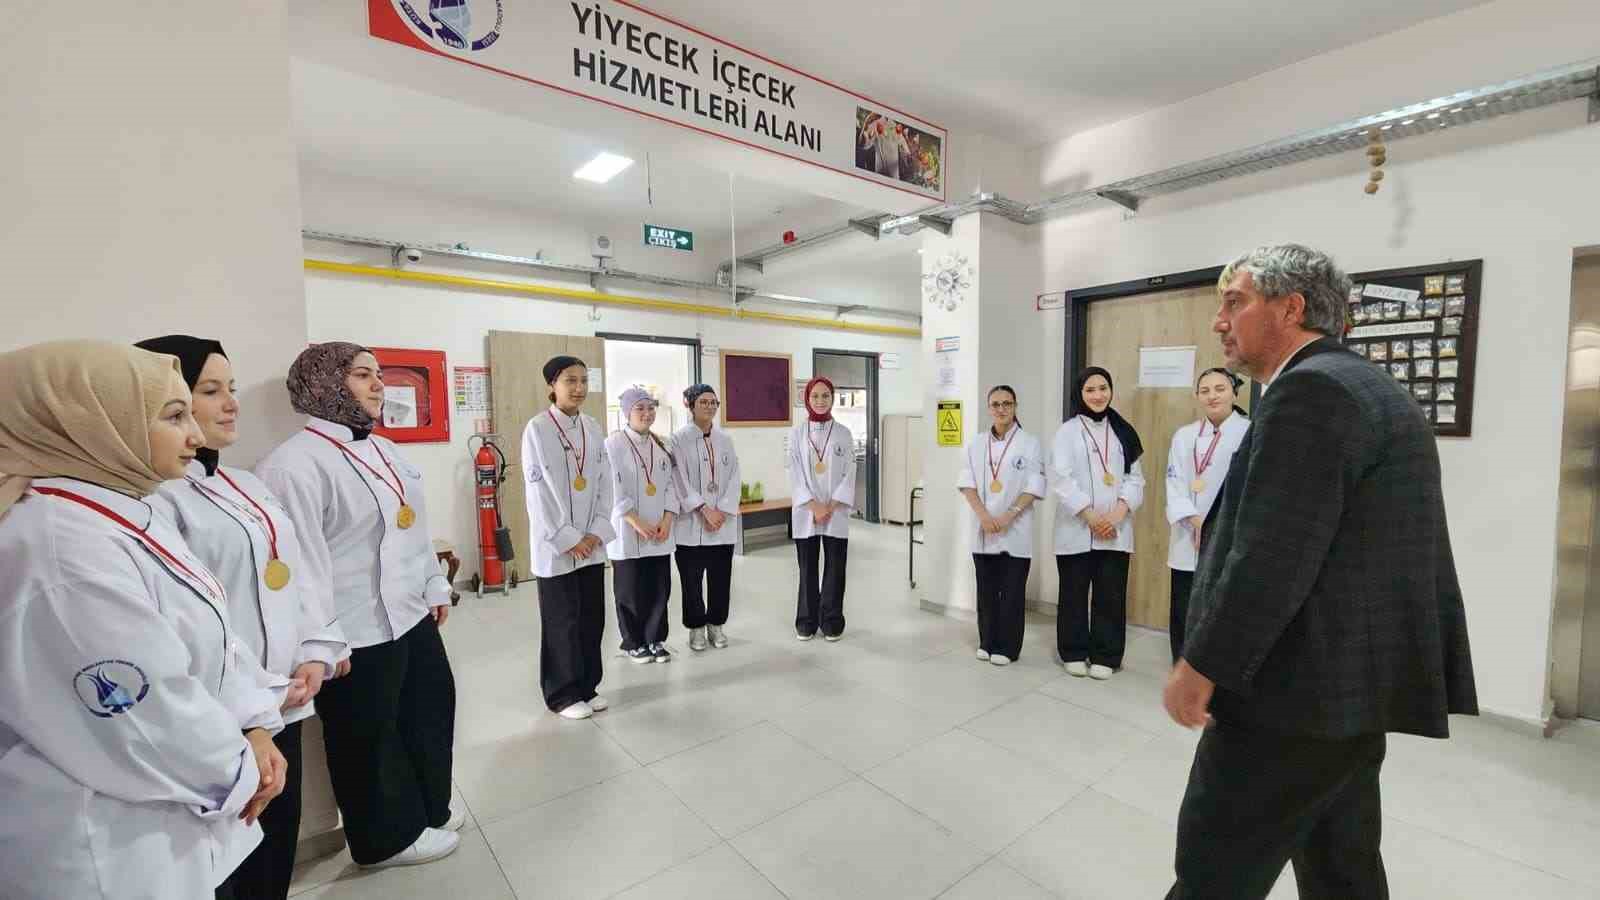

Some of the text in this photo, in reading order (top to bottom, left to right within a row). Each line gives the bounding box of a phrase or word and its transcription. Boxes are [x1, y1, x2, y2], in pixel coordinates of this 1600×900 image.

[571, 2, 796, 109] YİYECEK İÇECEK
[573, 47, 821, 152] HİZMETLERİ ALANI
[650, 228, 676, 239] EXIT
